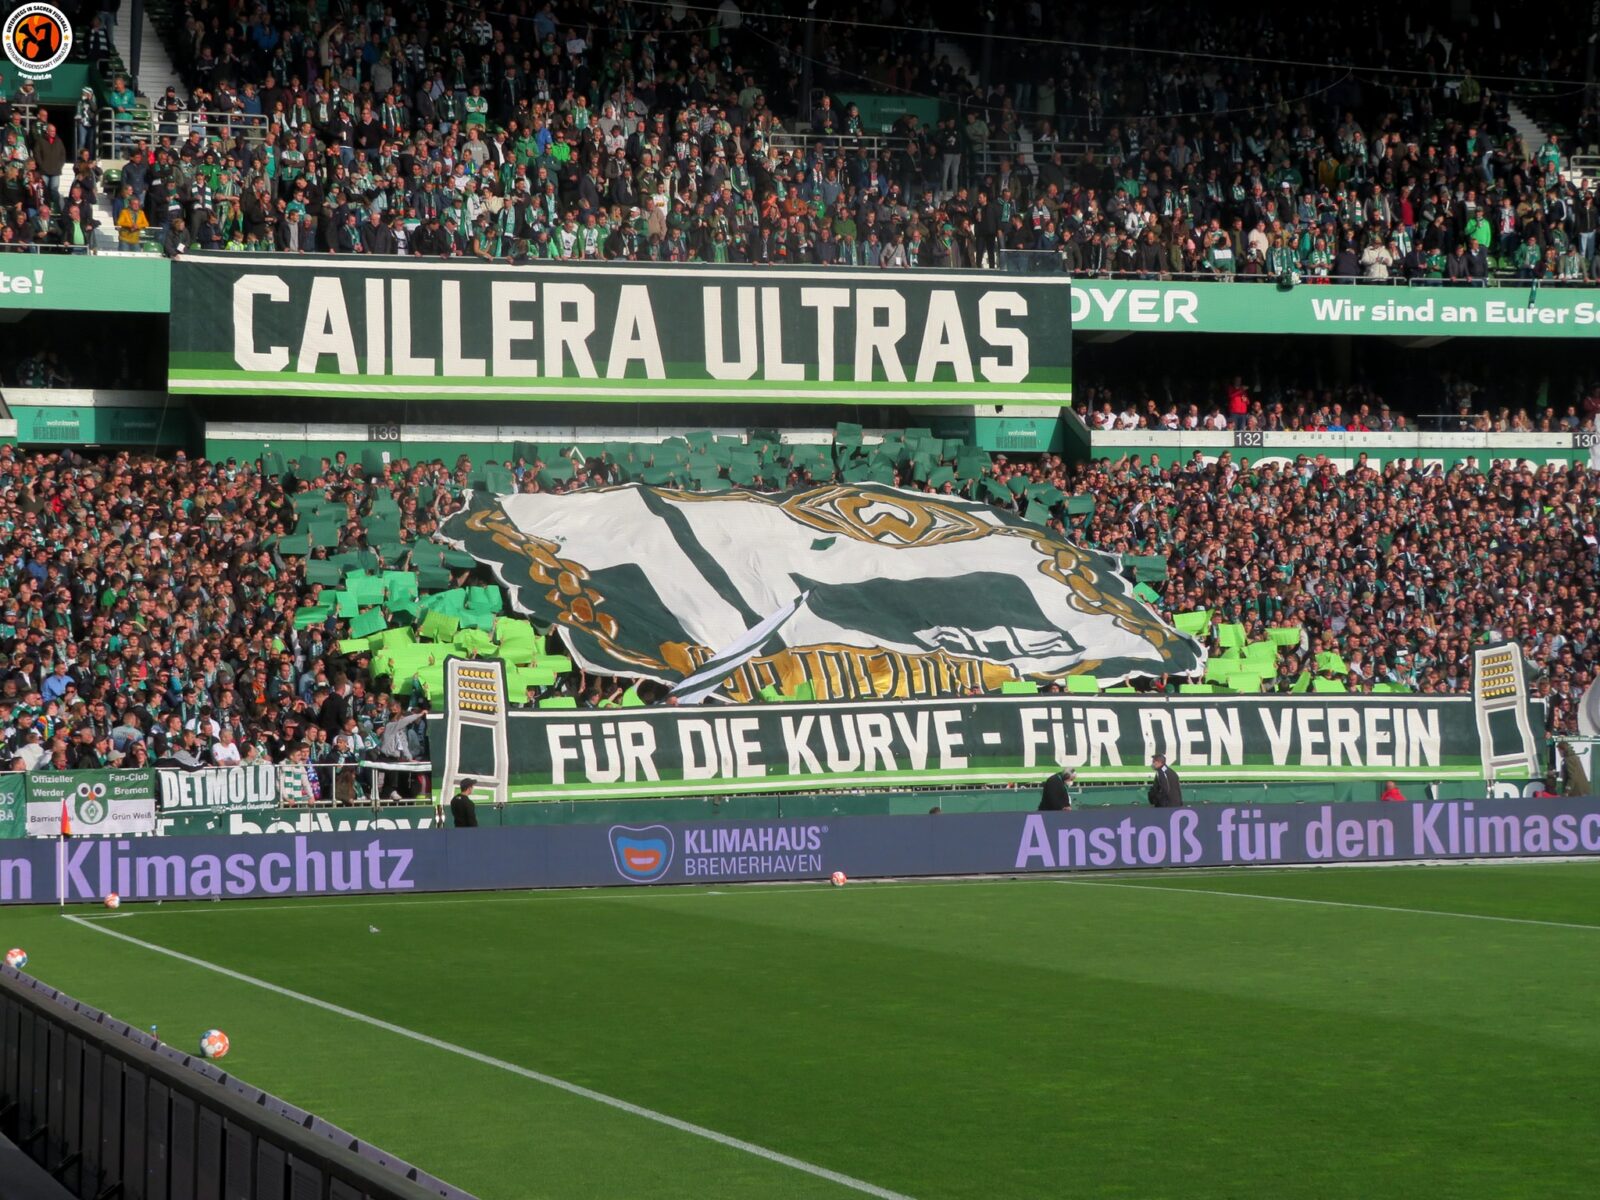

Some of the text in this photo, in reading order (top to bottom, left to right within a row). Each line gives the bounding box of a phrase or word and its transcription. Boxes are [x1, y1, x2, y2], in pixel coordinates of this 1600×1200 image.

[0, 269, 44, 294] te!
[1311, 298, 1600, 324] Wir sind an Eurer S
[233, 274, 1030, 384] CAILLERA ULTRAS
[371, 426, 398, 440] 136
[1236, 432, 1261, 446] 132
[1574, 434, 1599, 447] 130
[545, 707, 1441, 784] FÜR DIE KURVE - FÜR DEN VEREIN
[31, 773, 149, 783] Offizieller Fan-Club
[158, 765, 276, 808] DETMOLD
[32, 787, 149, 797] Werder Bremen
[112, 812, 131, 821] Grün
[133, 811, 152, 820] Weiß
[1016, 808, 1202, 869] Anstoß
[1217, 806, 1288, 863] für
[1304, 805, 1395, 860] den
[56, 835, 415, 899] Klimaschutz
[684, 854, 822, 877] BREMERHAVEN
